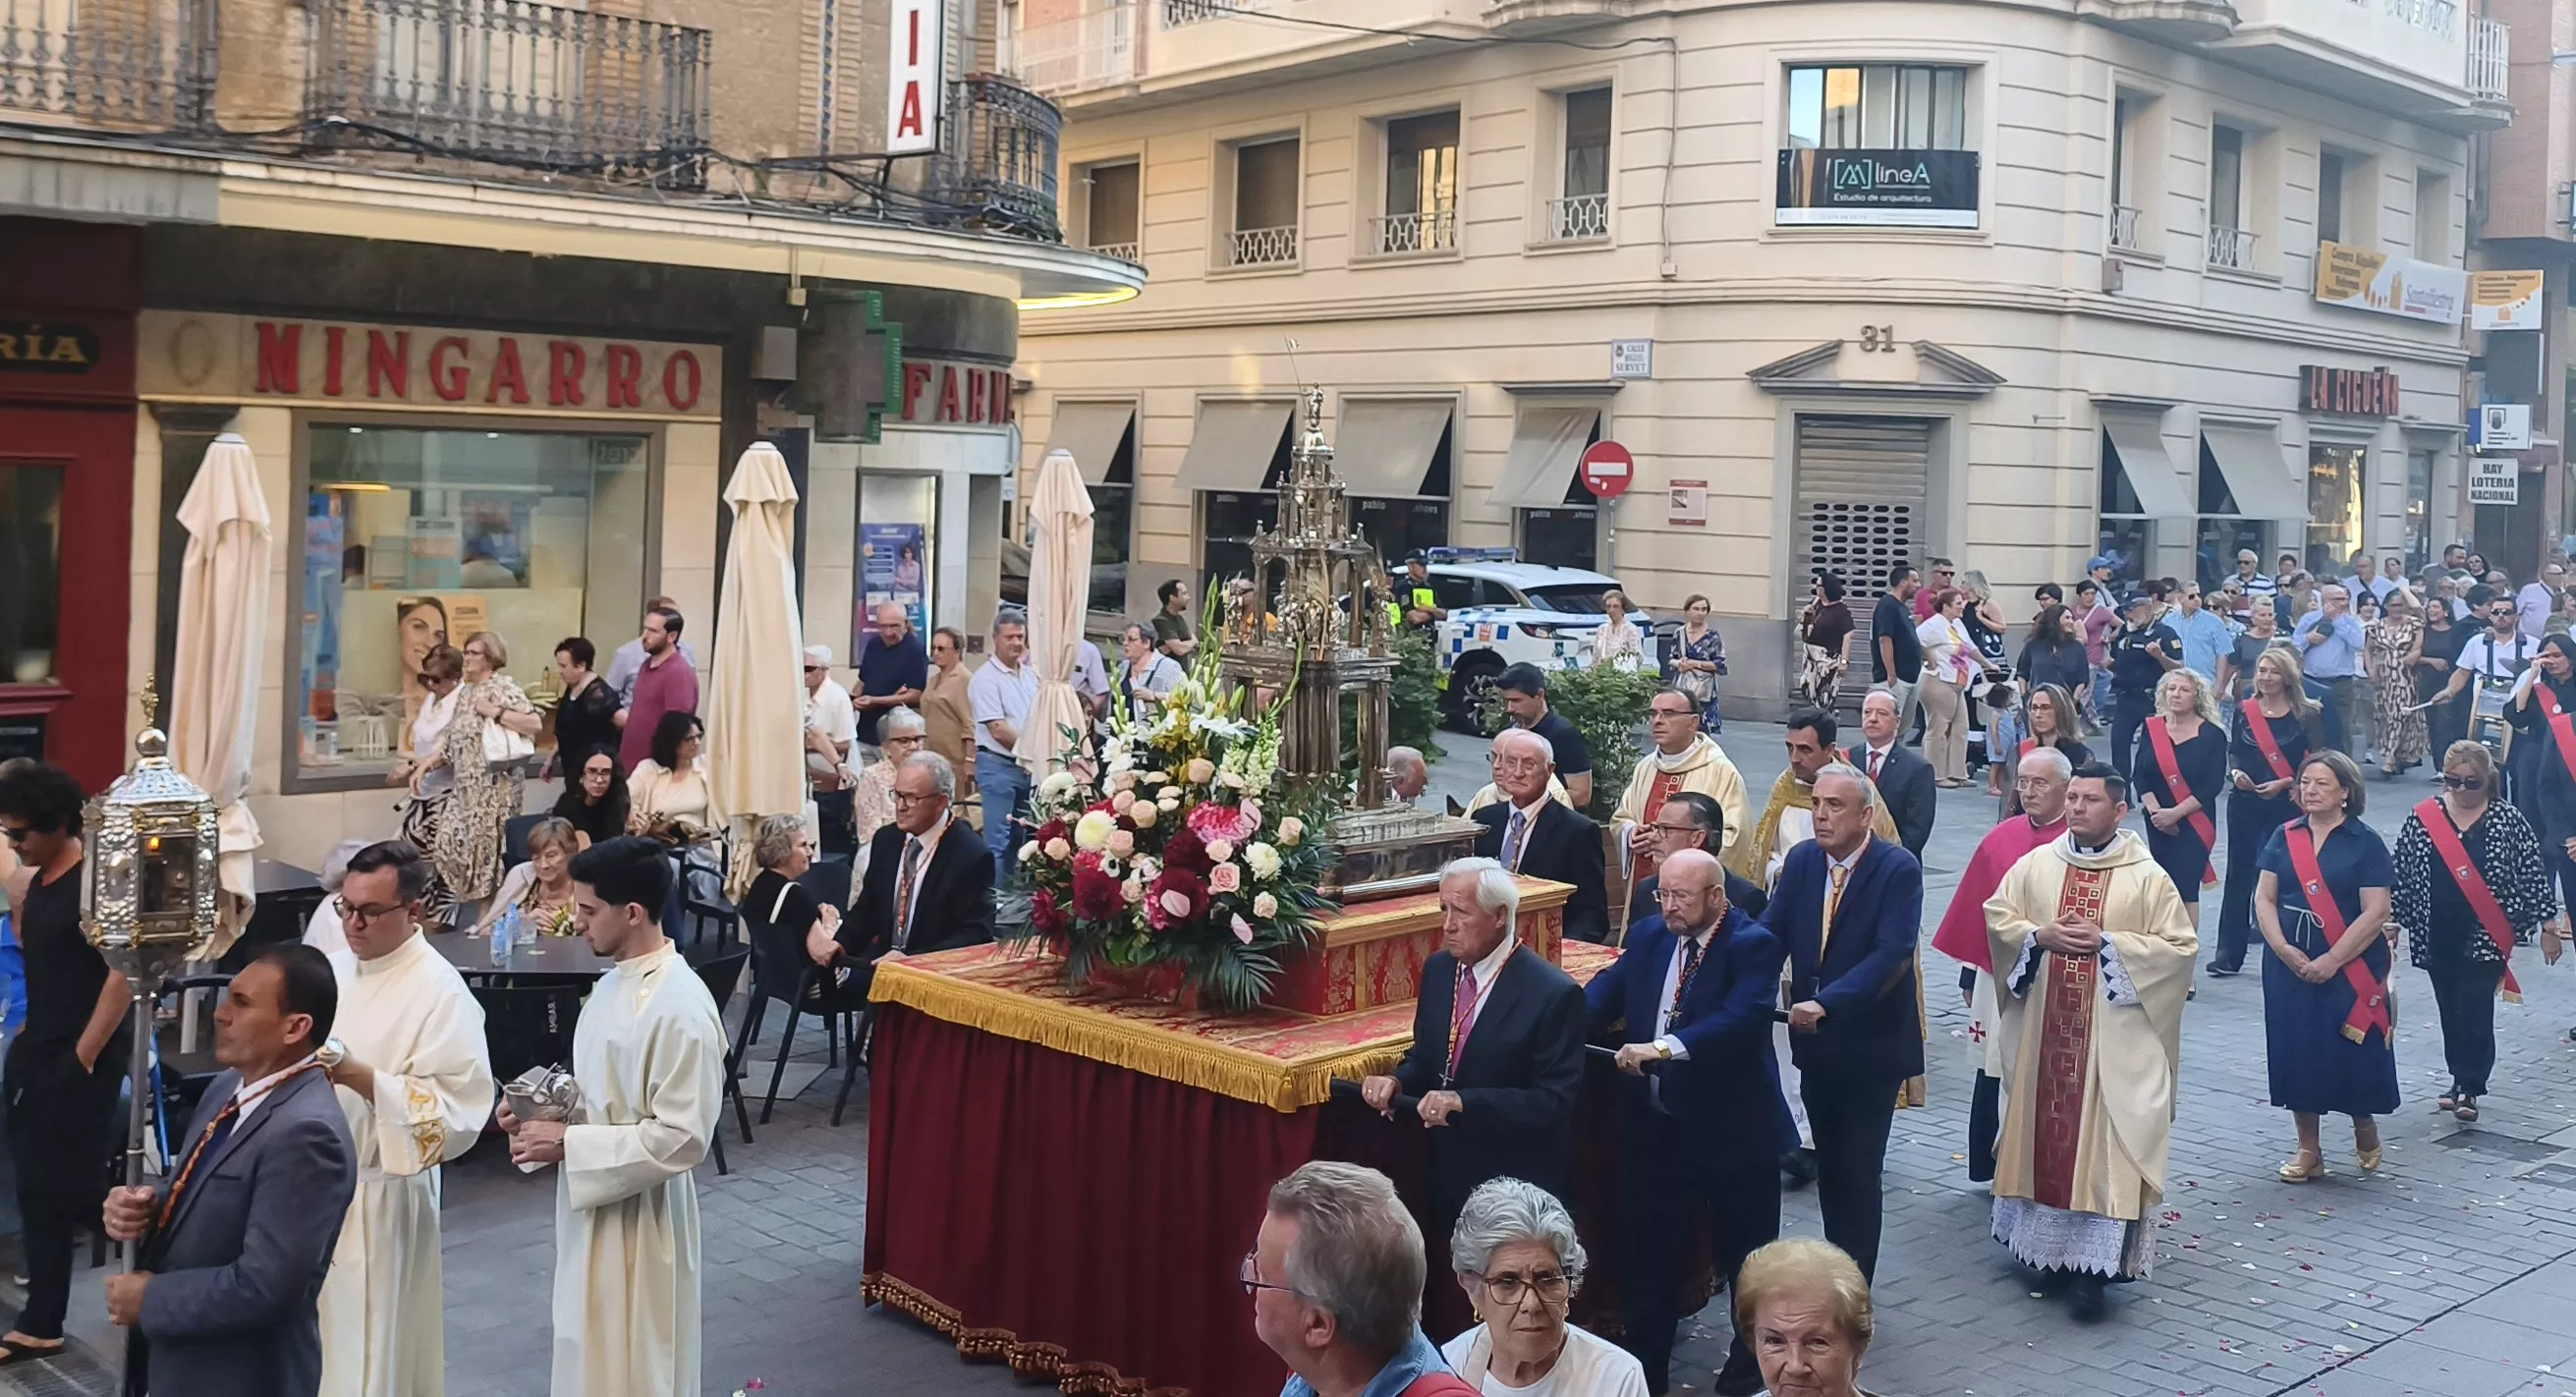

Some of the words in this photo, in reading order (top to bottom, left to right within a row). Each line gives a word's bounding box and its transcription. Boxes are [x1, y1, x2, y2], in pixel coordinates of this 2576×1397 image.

[1876, 162, 1931, 184] lineA
[1833, 193, 1866, 201] Estudio
[1860, 324, 1896, 353] 31
[255, 321, 701, 411] MINGARRO
[2312, 366, 2328, 410] LA
[2483, 464, 2503, 474] HAY
[2471, 476, 2514, 487] LOTERIA
[2471, 490, 2514, 501] NACIONAL
